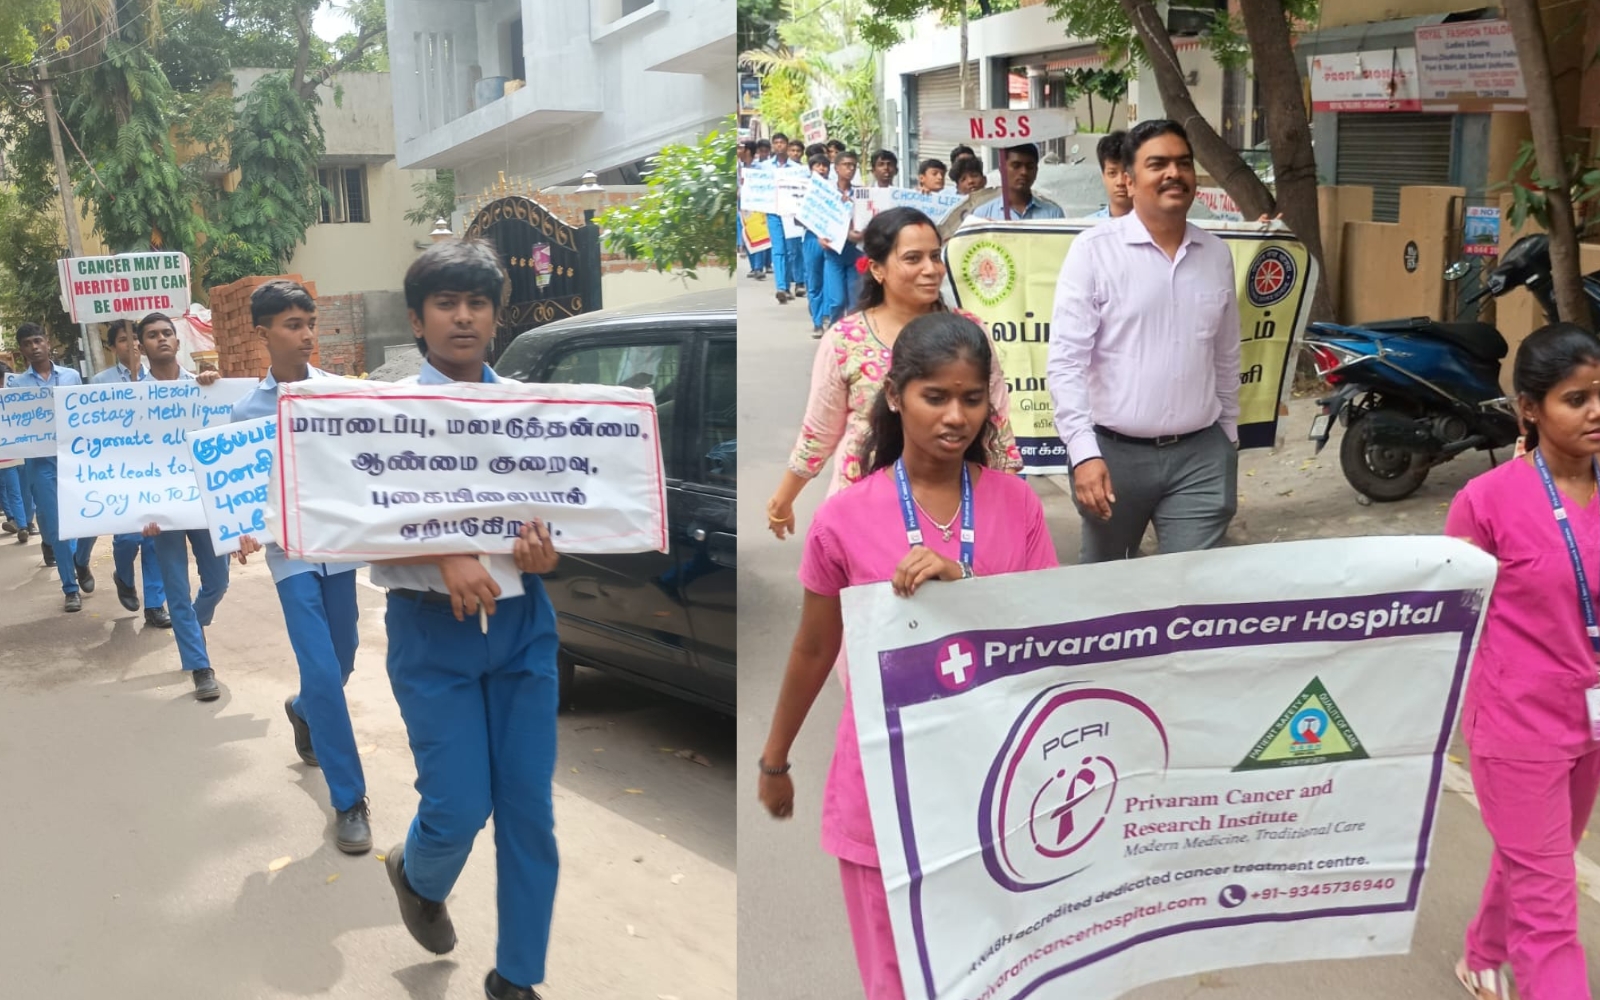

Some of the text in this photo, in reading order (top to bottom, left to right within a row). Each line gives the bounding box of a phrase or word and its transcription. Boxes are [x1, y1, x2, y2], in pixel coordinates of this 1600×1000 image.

[970, 115, 1031, 139] N.S.S
[78, 255, 180, 275] CANCER MAY BE
[74, 274, 187, 295] HERITED BUT CAN
[94, 295, 174, 314] BE OMITTED.
[148, 403, 187, 421] Meth
[75, 462, 114, 483] that
[120, 461, 162, 479] leads
[350, 451, 478, 476] ஆண்மை
[81, 490, 129, 519] Say
[372, 487, 587, 508] புகையிலையால்
[400, 517, 561, 542] ஏற்படுகிற.
[984, 601, 1445, 667] Privaram Cancer Hospital
[1319, 693, 1342, 722] QUALITY
[1342, 728, 1360, 749] CARE
[1124, 779, 1334, 814] Privaram Cancer and
[1123, 810, 1299, 839] Research Institute
[1124, 821, 1367, 858] Modern Medicine, Traditional Care
[1015, 895, 1093, 940] accredited
[1094, 871, 1171, 904] dedicated
[1174, 865, 1230, 882] cancer
[1232, 859, 1314, 874] treatment
[1317, 855, 1370, 869] centre.
